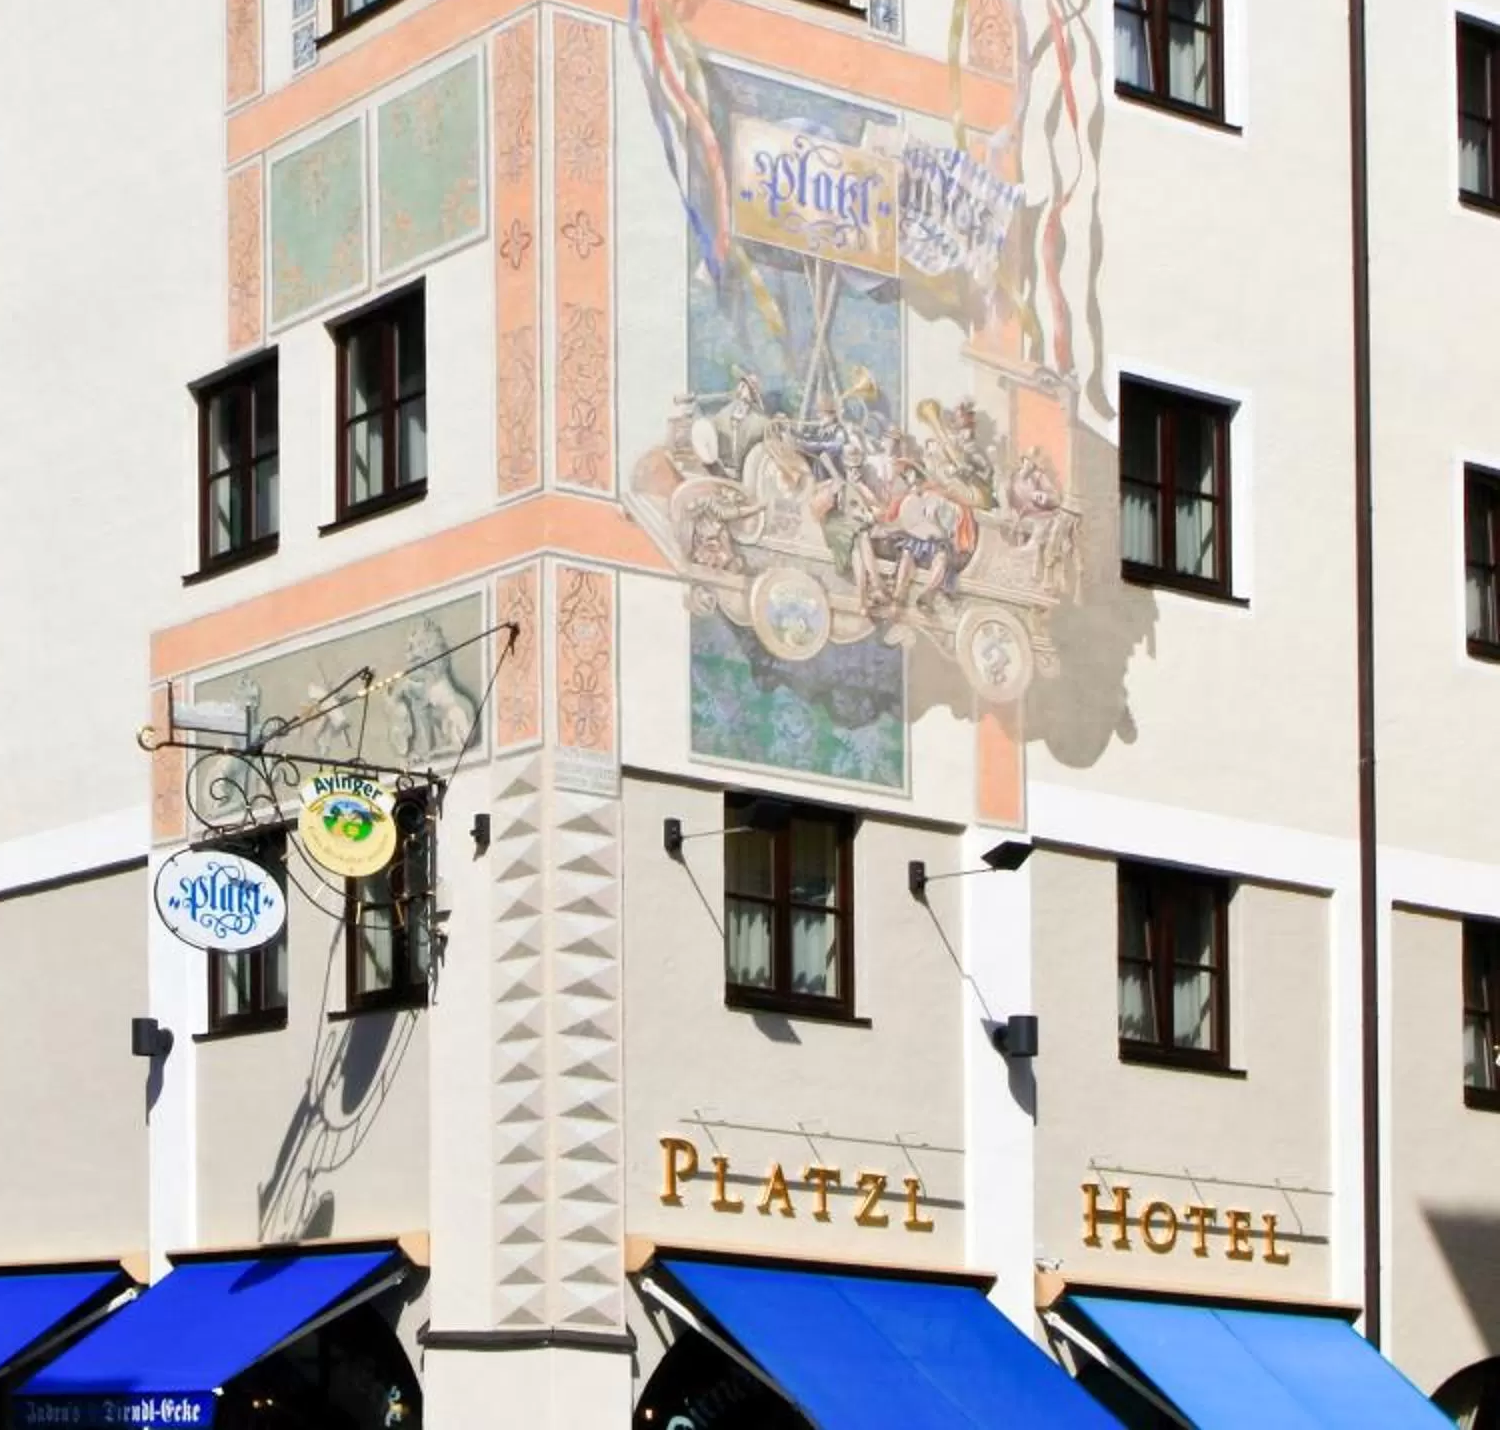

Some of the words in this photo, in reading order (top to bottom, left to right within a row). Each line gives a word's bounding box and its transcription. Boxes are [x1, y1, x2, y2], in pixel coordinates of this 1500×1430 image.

[313, 774, 384, 800] Ayinger
[659, 1137, 935, 1233] PLATZL
[1081, 1182, 1291, 1266] HOTEL
